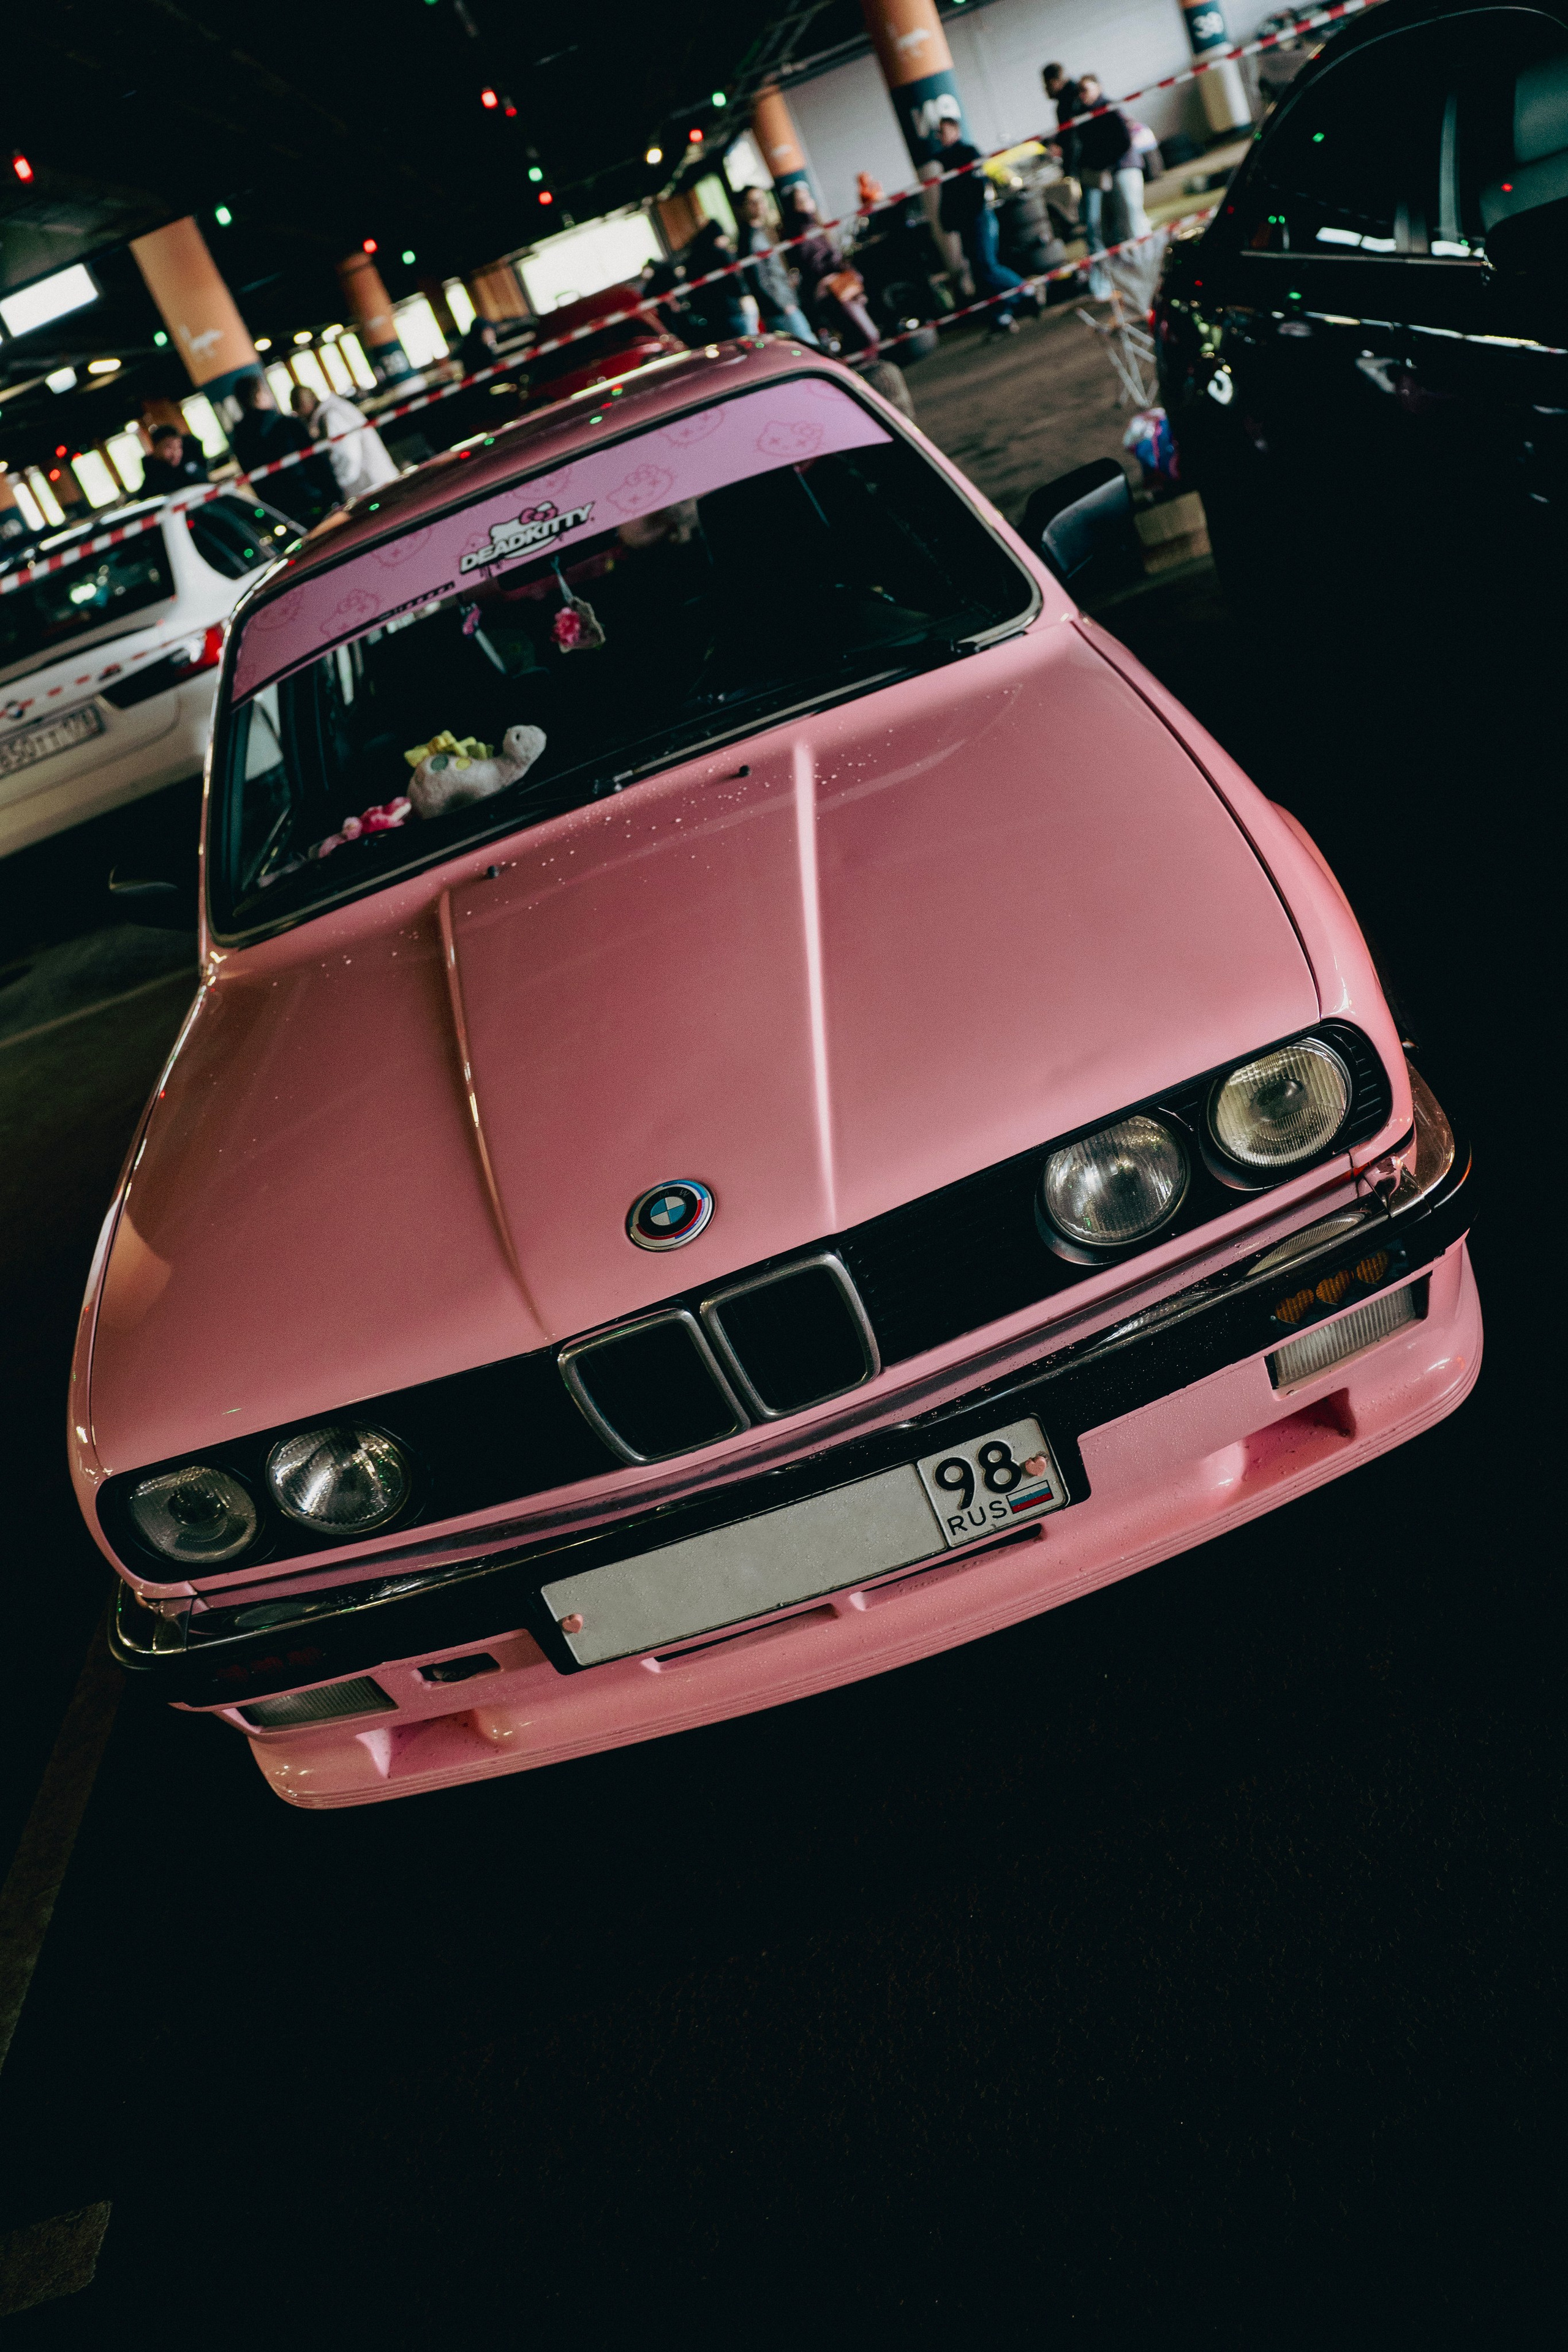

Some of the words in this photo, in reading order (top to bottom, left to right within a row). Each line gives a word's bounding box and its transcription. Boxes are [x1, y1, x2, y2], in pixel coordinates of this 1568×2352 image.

[460, 500, 595, 574] DEADKITTY
[935, 1441, 1022, 1510] 98
[948, 1501, 1008, 1536] RUS
